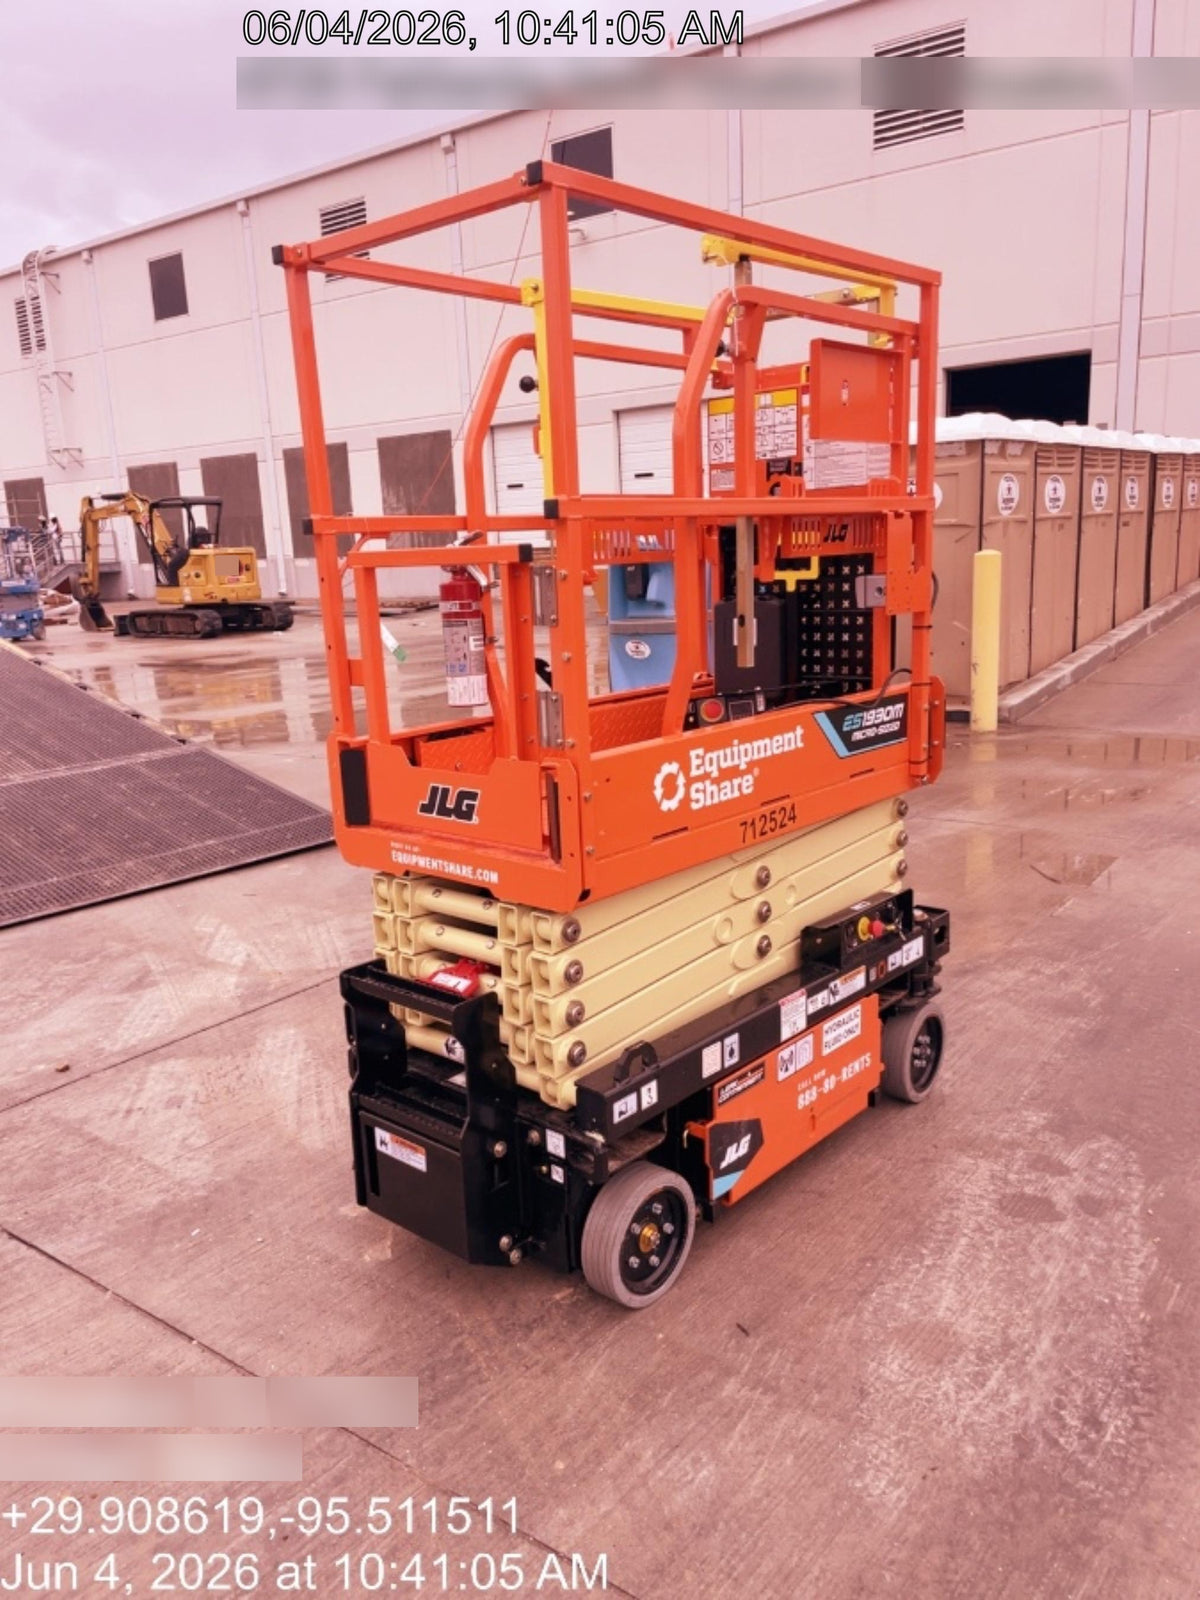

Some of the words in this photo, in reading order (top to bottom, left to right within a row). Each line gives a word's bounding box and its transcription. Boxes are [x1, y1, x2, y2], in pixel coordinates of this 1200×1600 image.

[824, 523, 849, 543] JLG
[842, 702, 905, 732] ES1930M
[689, 725, 804, 778] Equipment
[418, 784, 480, 824] JLG
[739, 802, 798, 844] 712524
[391, 849, 499, 884] EQUIPMENTSHARE.COM
[824, 1008, 860, 1035] HYDRAULIC
[719, 1133, 752, 1170] JLG
